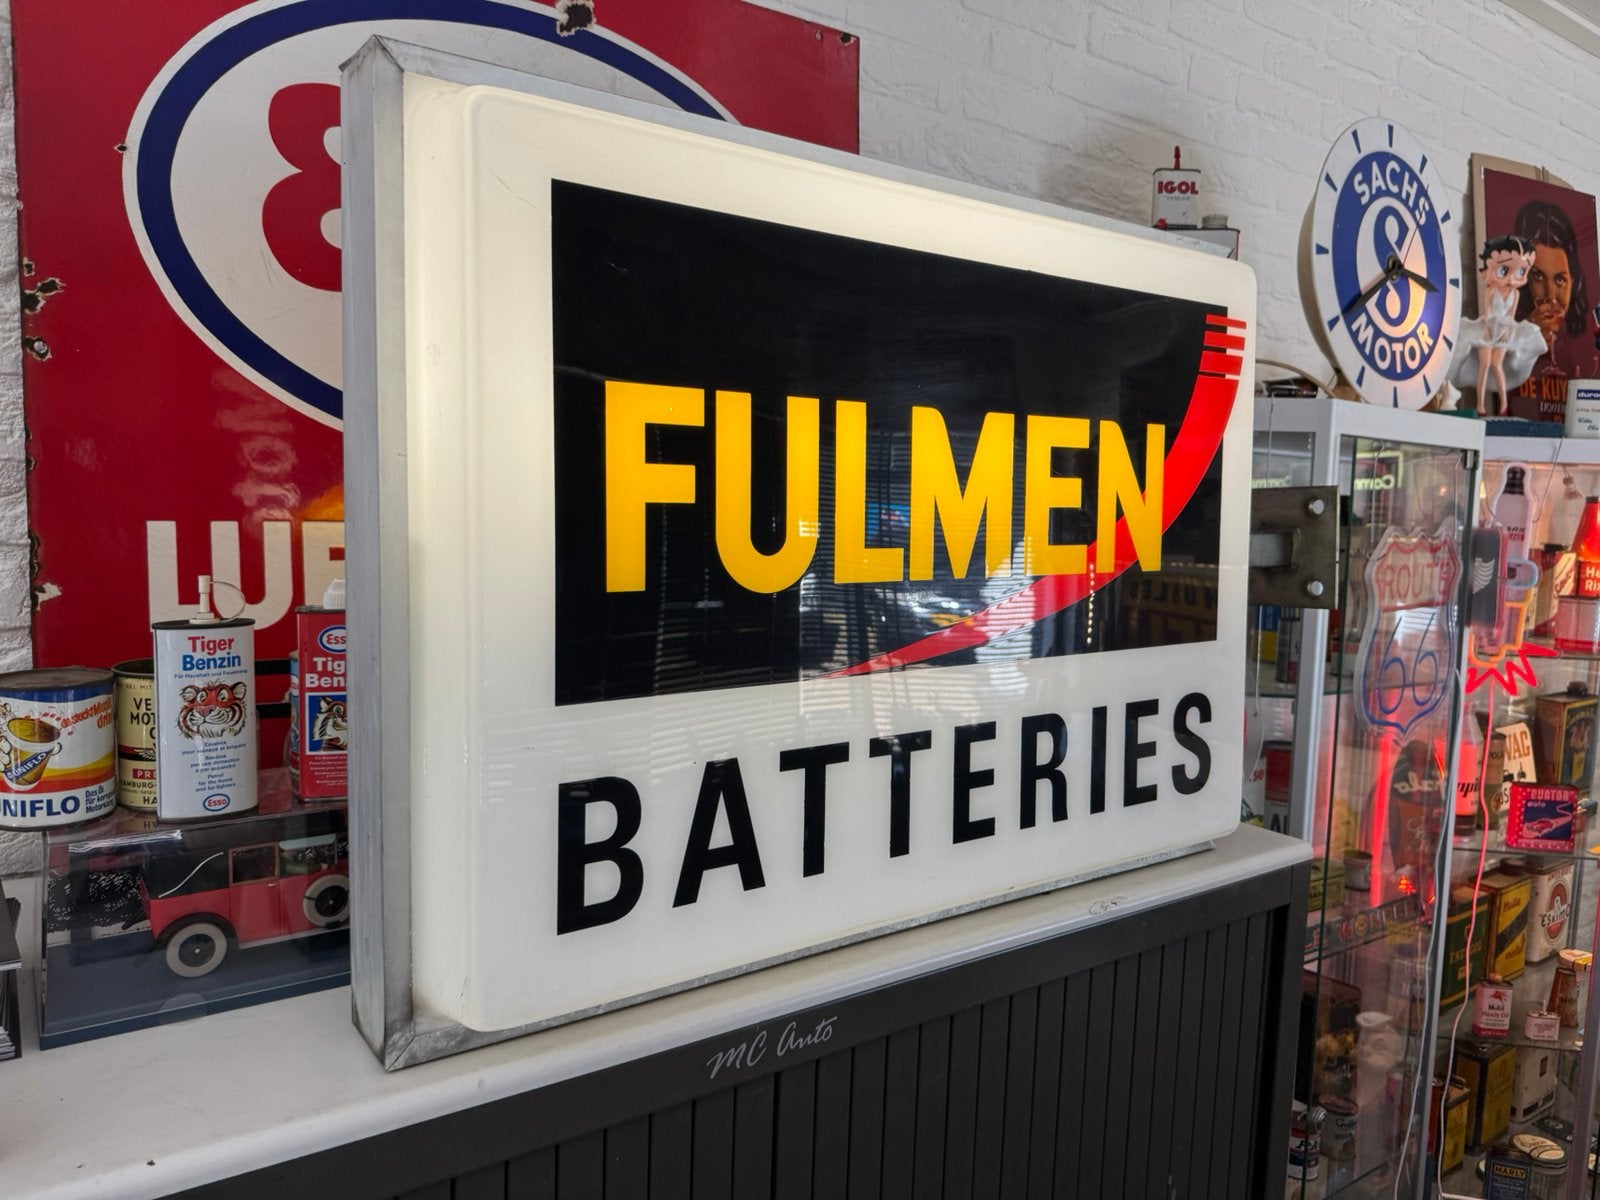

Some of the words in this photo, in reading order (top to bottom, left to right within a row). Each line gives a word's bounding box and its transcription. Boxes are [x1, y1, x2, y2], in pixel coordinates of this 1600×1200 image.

[1157, 181, 1198, 195] IGOL
[1353, 160, 1429, 226] SACHS
[1351, 311, 1434, 374] MOTOR
[605, 380, 1166, 594] FULMEN
[1381, 558, 1450, 601] ROUTE
[182, 652, 241, 671] Benzin
[187, 636, 235, 656] Tiger
[313, 657, 346, 673] Tig
[1378, 612, 1438, 715] 66
[14, 752, 47, 776] UNIFLO
[0, 795, 80, 818] NIFLO
[207, 799, 228, 807] Esso
[557, 691, 1212, 936] BATTERIES
[706, 1030, 767, 1080] MC
[776, 1016, 838, 1057] Auto
